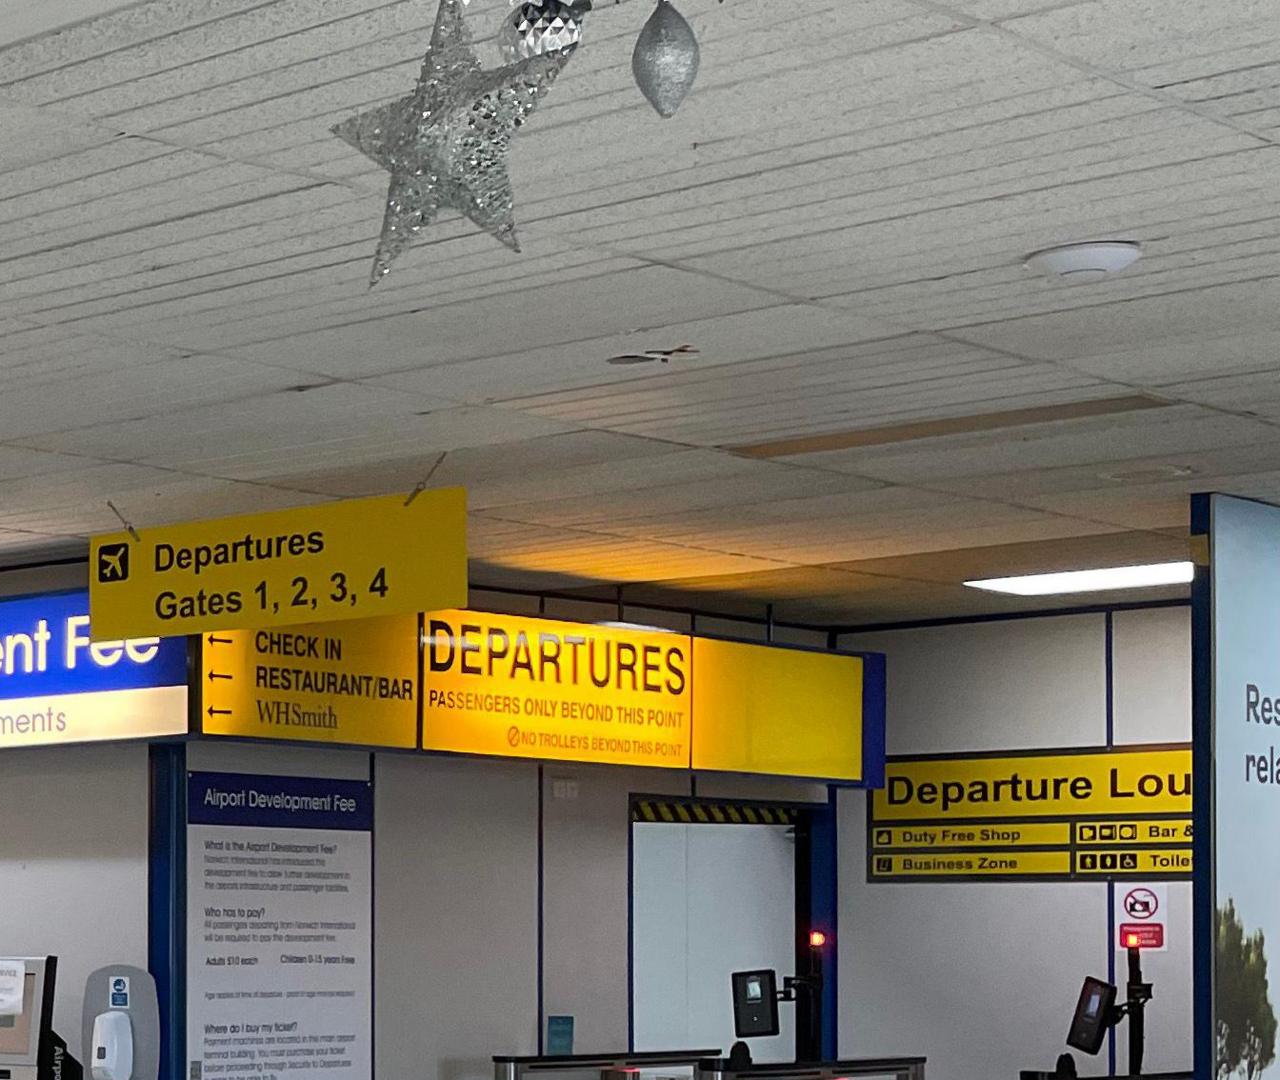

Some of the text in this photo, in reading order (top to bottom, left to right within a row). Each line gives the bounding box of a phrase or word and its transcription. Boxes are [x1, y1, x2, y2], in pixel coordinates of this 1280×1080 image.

[154, 531, 324, 574] Departures
[155, 567, 388, 620] Gates 1, 2, 3, 4
[66, 615, 161, 670] Fee
[255, 631, 342, 661] CHECK IN
[429, 619, 686, 696] DEPARTURES
[255, 665, 414, 702] RESTAURANT/BAR
[256, 699, 338, 729] WHSmith
[429, 689, 684, 728] PASSENGERS ONLY BEYOND THIS POINT
[1246, 683, 1280, 727] Res
[521, 732, 682, 758] NO TROLLEYS BEYOND THIS POINT
[204, 788, 357, 812] Airport Development Fee
[888, 768, 1191, 811] Departure Lou
[902, 829, 1021, 844] Duty Free Shop
[1149, 825, 1193, 837] Bar &
[902, 857, 1018, 870] Business Zone
[1150, 854, 1193, 867] Toile
[204, 906, 265, 920] Who has to pay?
[204, 1024, 228, 1034] Where
[229, 1024, 240, 1034] do
[245, 1024, 260, 1035] buy
[261, 1024, 273, 1035] my
[274, 1021, 298, 1033] ticket?
